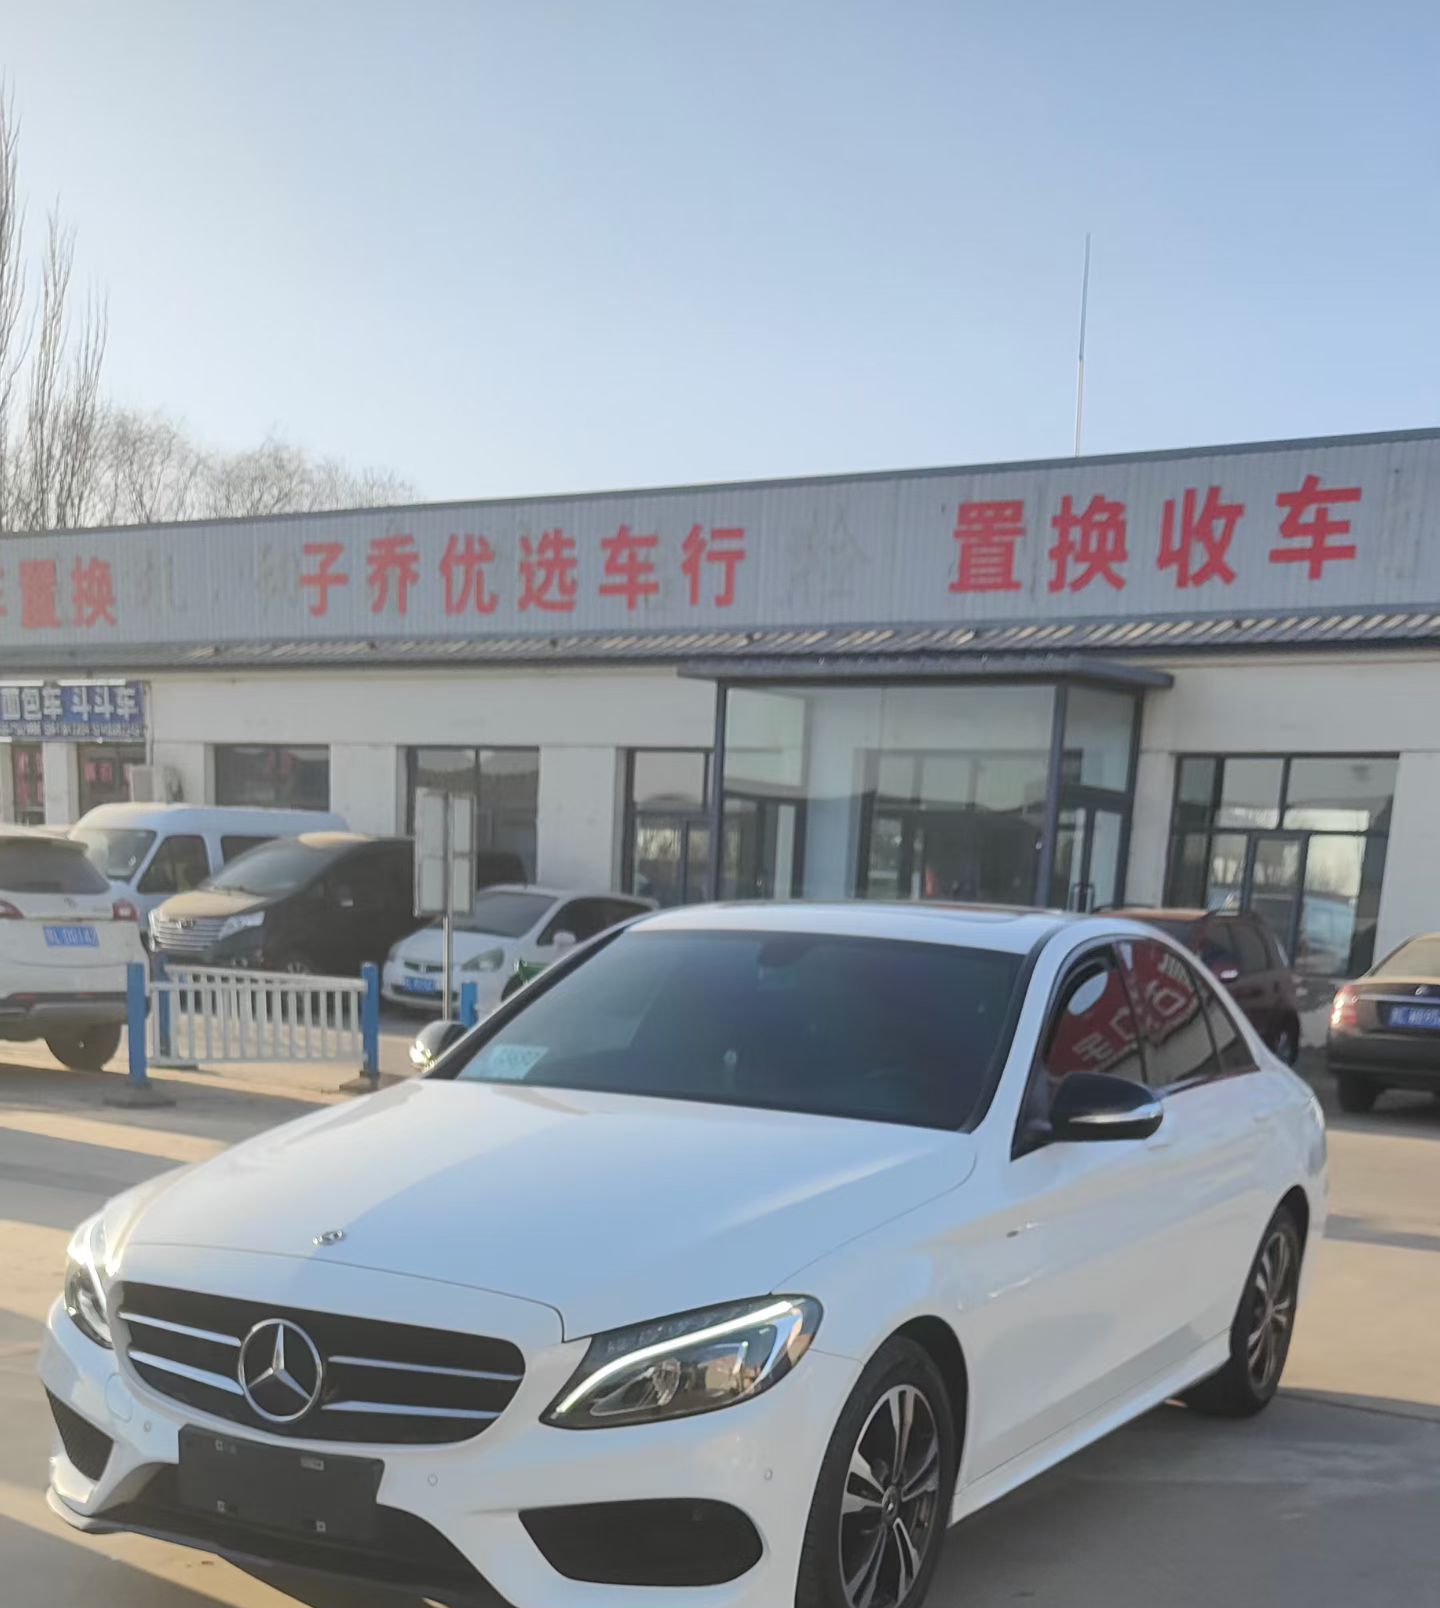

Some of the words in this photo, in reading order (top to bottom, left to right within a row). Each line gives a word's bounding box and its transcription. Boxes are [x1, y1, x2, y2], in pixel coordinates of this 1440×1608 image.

[300, 523, 747, 617] 子乔优选车行
[949, 474, 1363, 594] 置换收车
